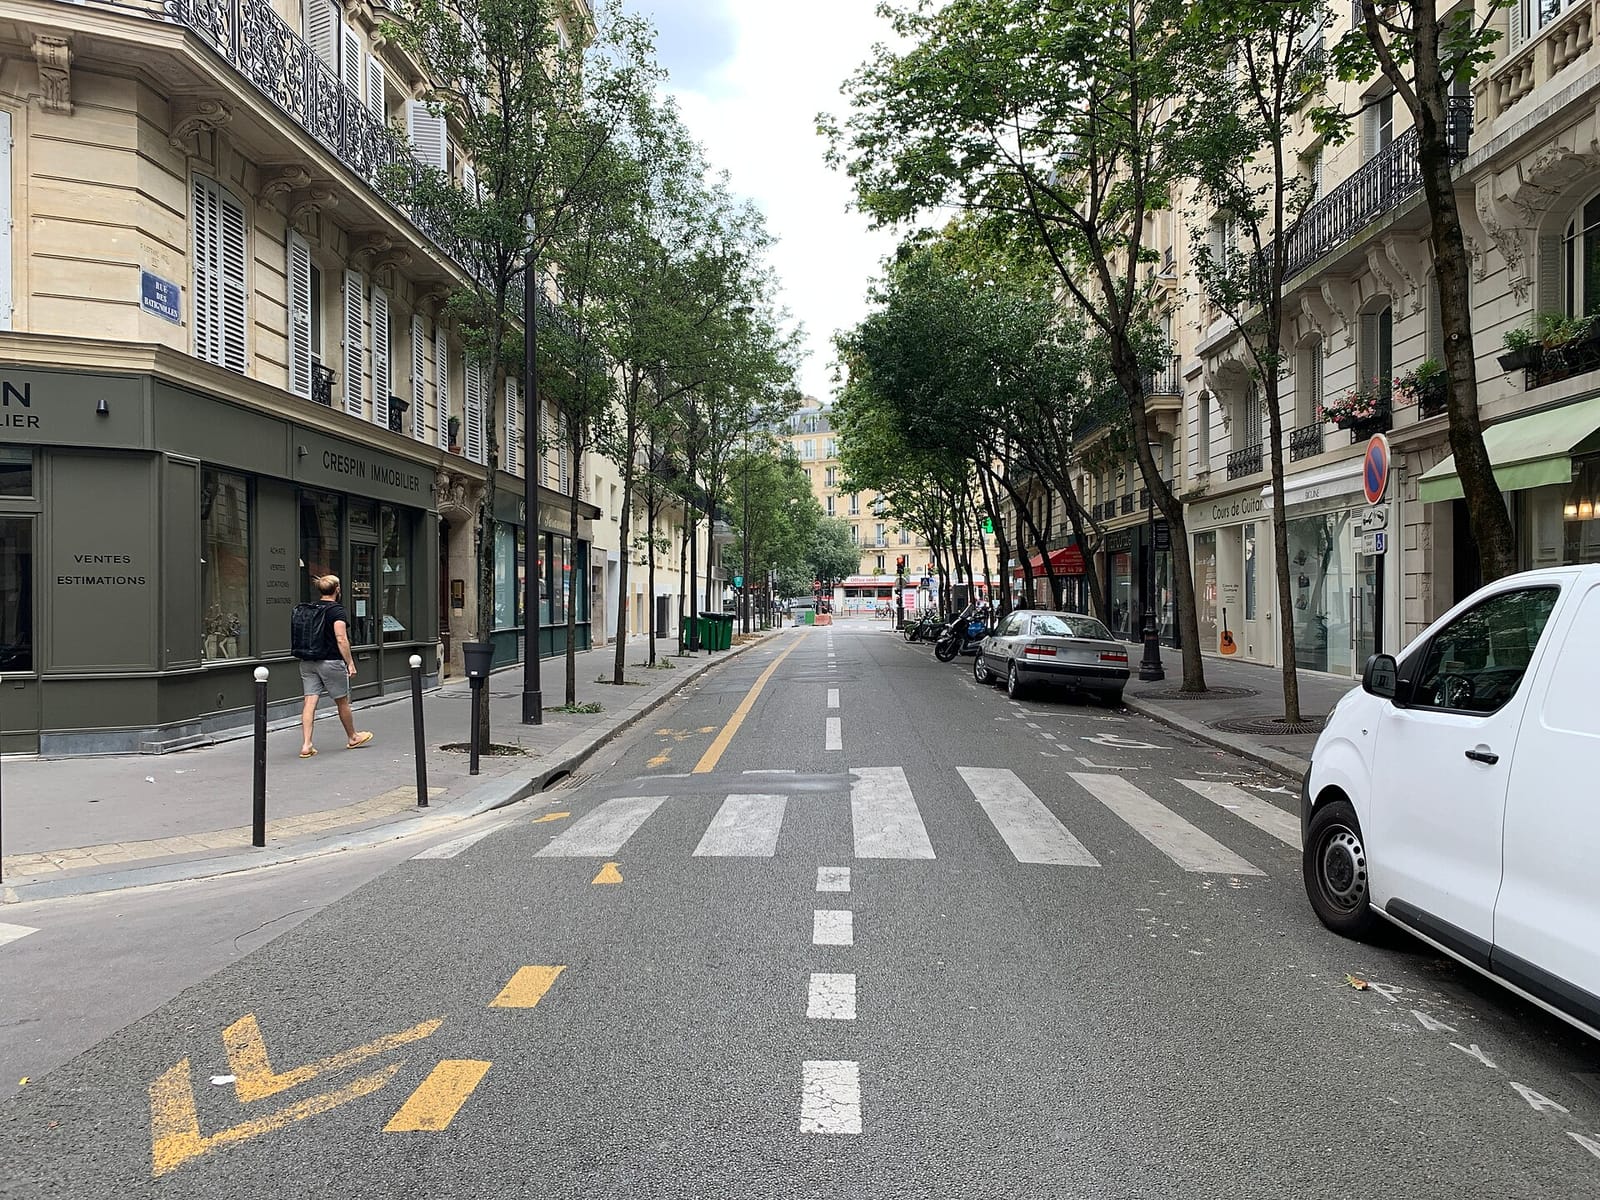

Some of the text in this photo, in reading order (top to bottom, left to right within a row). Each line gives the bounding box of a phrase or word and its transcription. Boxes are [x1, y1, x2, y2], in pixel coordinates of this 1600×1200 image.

[156, 281, 168, 293] RUE
[156, 292, 167, 303] DES
[144, 296, 178, 318] BATIGNOLLES
[322, 450, 420, 492] CRESPIN IMMOBILIER
[1212, 504, 1230, 520] Cours
[1231, 500, 1240, 516] de
[74, 554, 131, 564] VENTES
[57, 576, 146, 585] ESTIMATIONS
